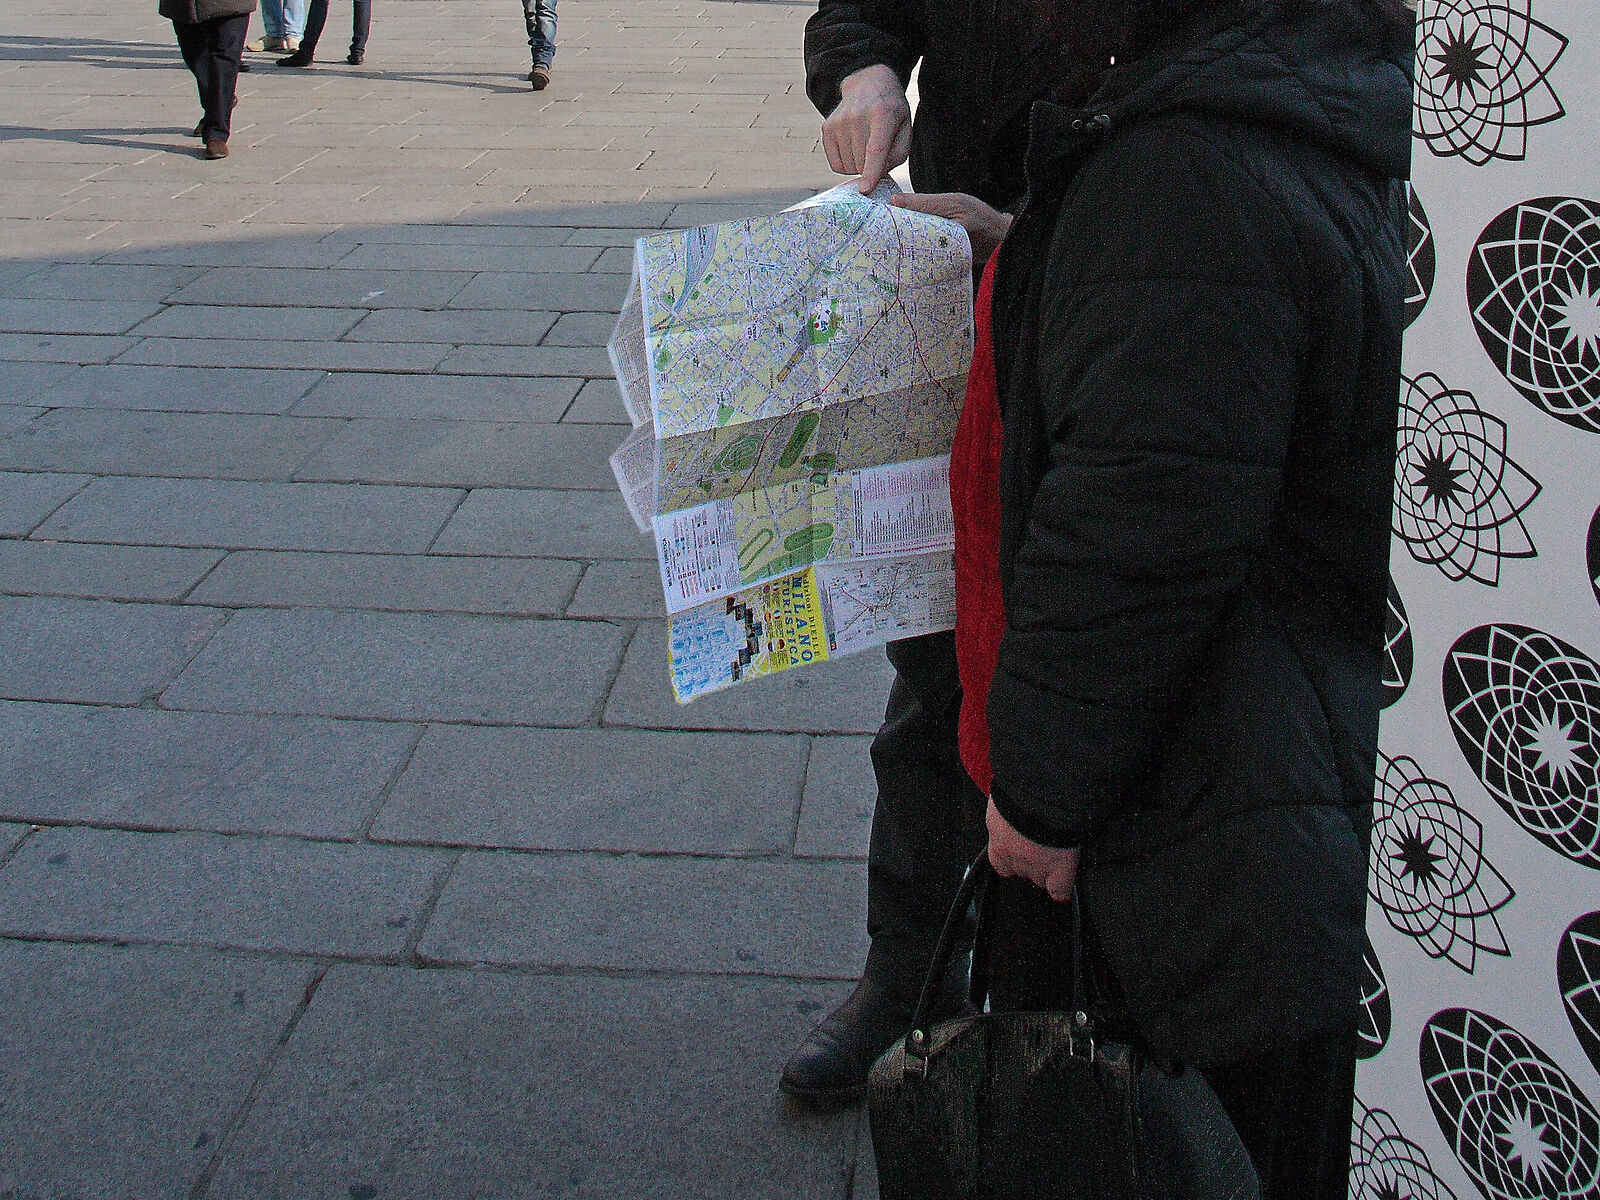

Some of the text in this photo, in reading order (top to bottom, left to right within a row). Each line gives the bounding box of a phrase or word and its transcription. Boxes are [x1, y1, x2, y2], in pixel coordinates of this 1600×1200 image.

[783, 578, 799, 665] TURISTICA
[792, 576, 813, 662] MILANO
[808, 616, 820, 656] DIELLE
